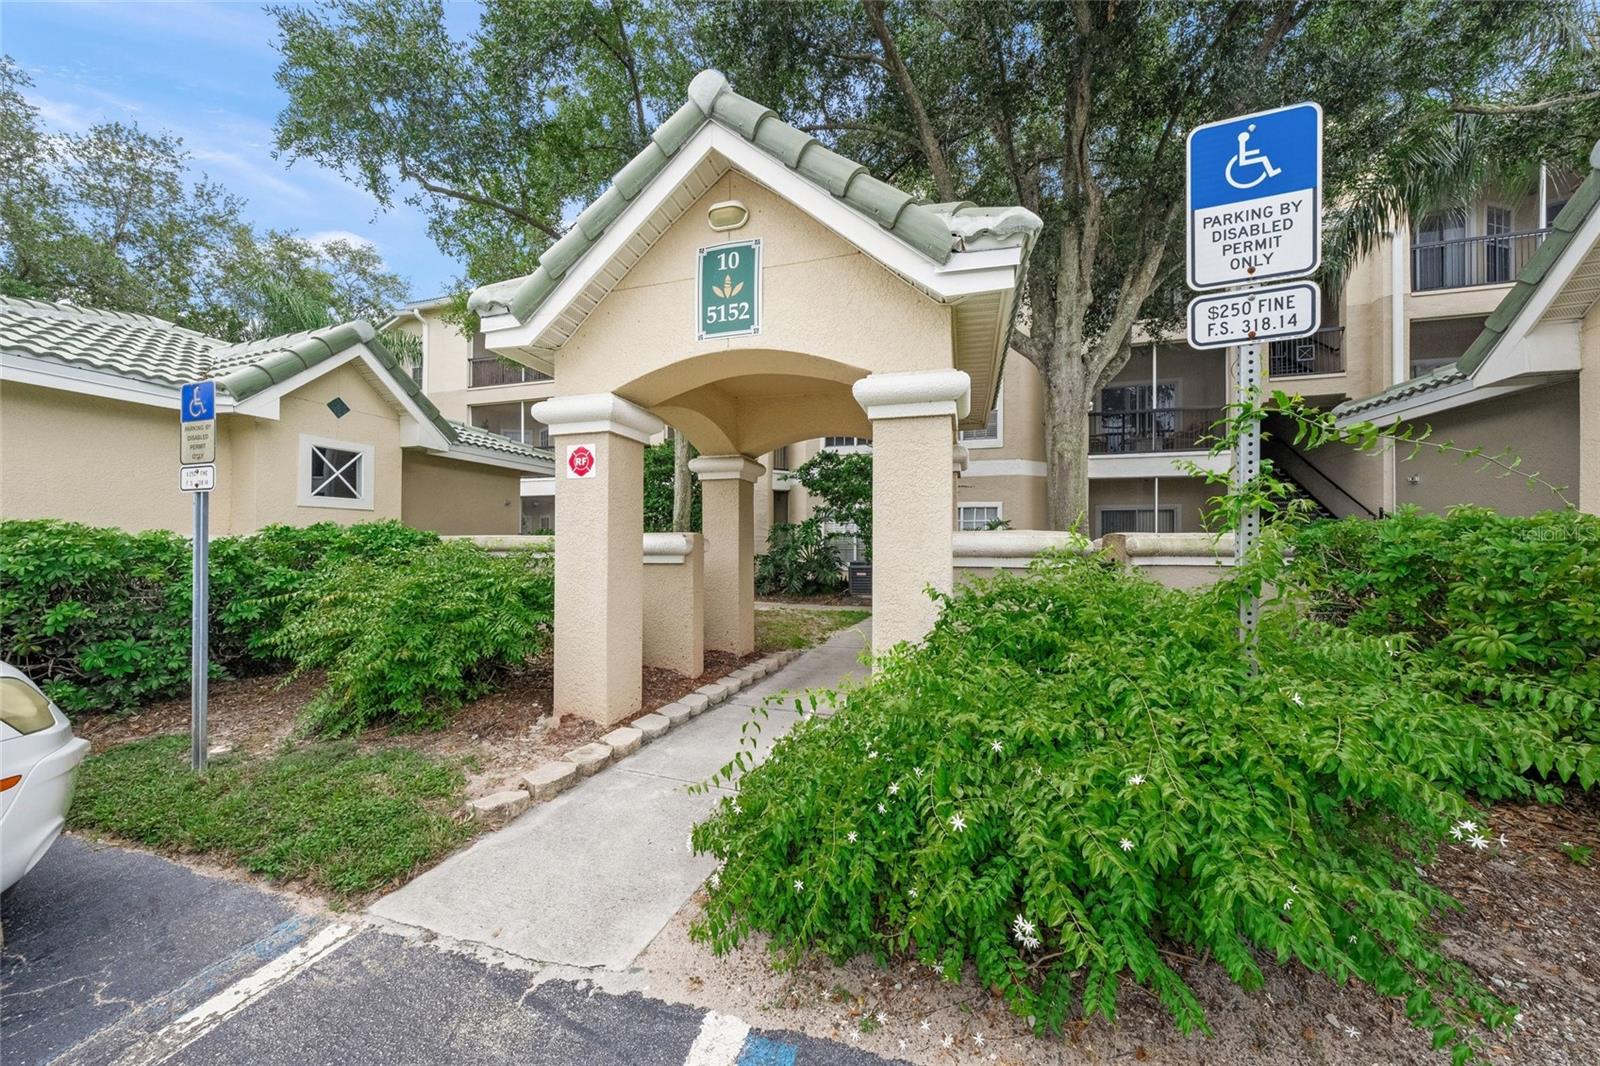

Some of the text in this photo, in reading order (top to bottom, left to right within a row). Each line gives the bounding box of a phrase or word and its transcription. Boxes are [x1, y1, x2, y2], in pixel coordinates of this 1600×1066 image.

[1203, 199, 1303, 229] PARKING BY
[1212, 217, 1294, 243] DISABLED
[1222, 235, 1282, 257] PERMIT
[717, 251, 740, 271] 10
[1230, 252, 1274, 270] ONLY
[706, 301, 750, 324] 5152
[1207, 294, 1296, 321] $250 FINE
[1207, 313, 1298, 337] F.S. 318.14
[576, 457, 587, 465] RF
